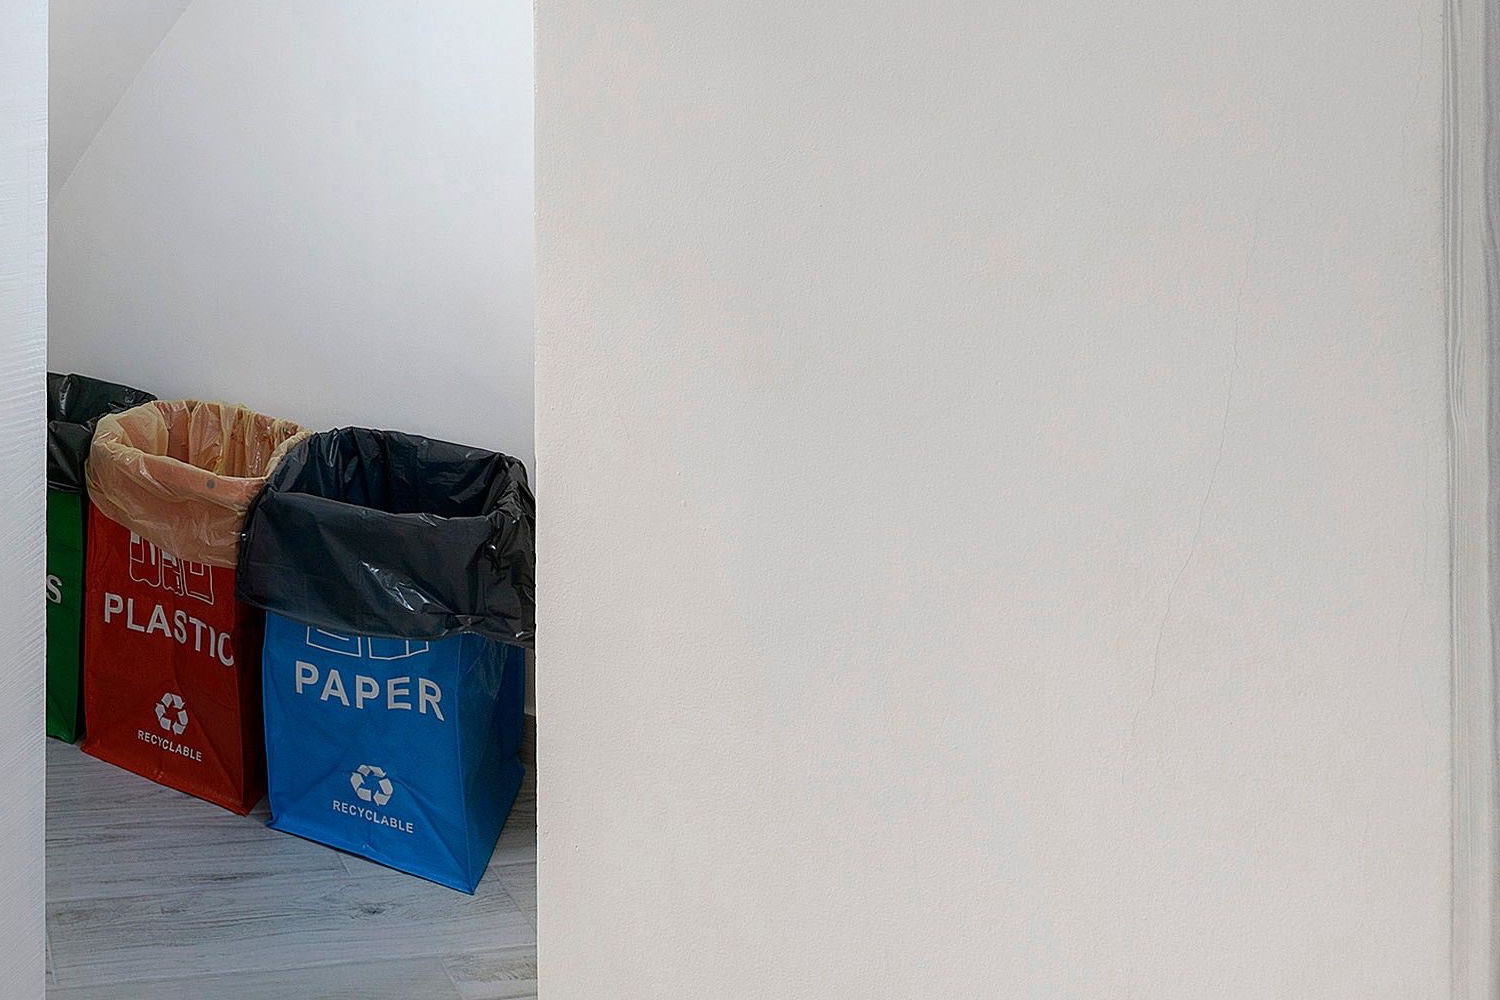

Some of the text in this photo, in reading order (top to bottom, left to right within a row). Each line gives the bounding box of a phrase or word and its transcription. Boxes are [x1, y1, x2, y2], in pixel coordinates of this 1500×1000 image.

[104, 592, 235, 667] PLASTIC
[295, 660, 445, 722] PAPER
[137, 729, 203, 762] RECYCLABLE
[332, 799, 414, 834] RECYCLABLE
